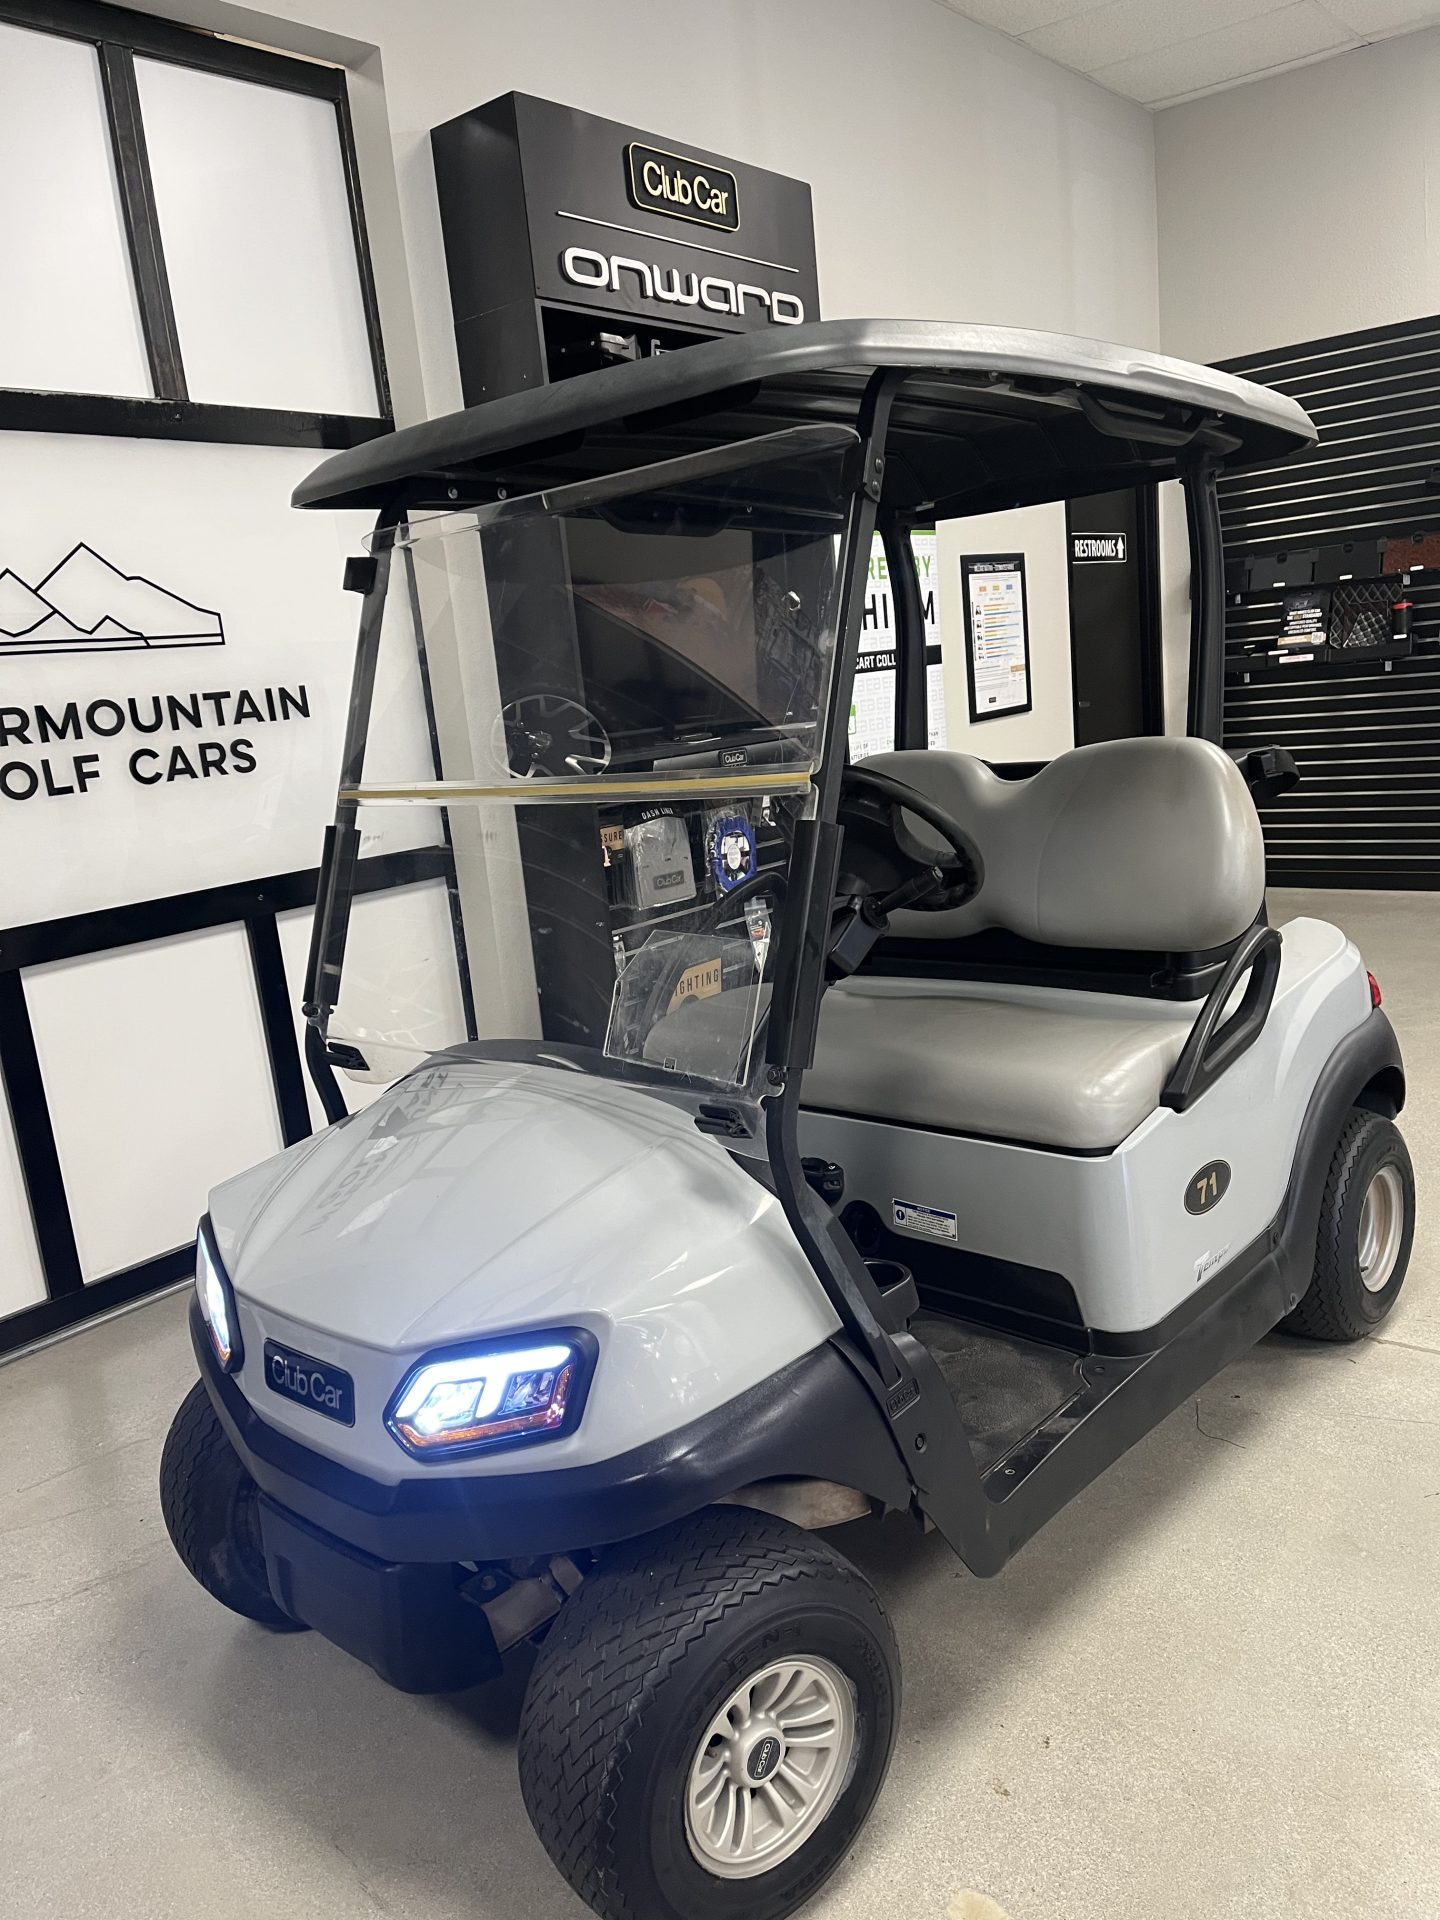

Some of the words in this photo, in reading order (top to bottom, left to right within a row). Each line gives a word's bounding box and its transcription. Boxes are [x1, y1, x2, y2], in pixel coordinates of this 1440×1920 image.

[643, 161, 692, 205] Club
[694, 175, 729, 216] Car
[1074, 539, 1116, 557] RESTROOMS
[0, 685, 311, 746] RMOUNTAIN
[0, 754, 100, 800] OLF
[129, 739, 257, 785] CARS
[641, 808, 660, 820] DASH
[1196, 1171, 1218, 1205] 71
[272, 1355, 308, 1395] Club
[310, 1373, 342, 1409] Car
